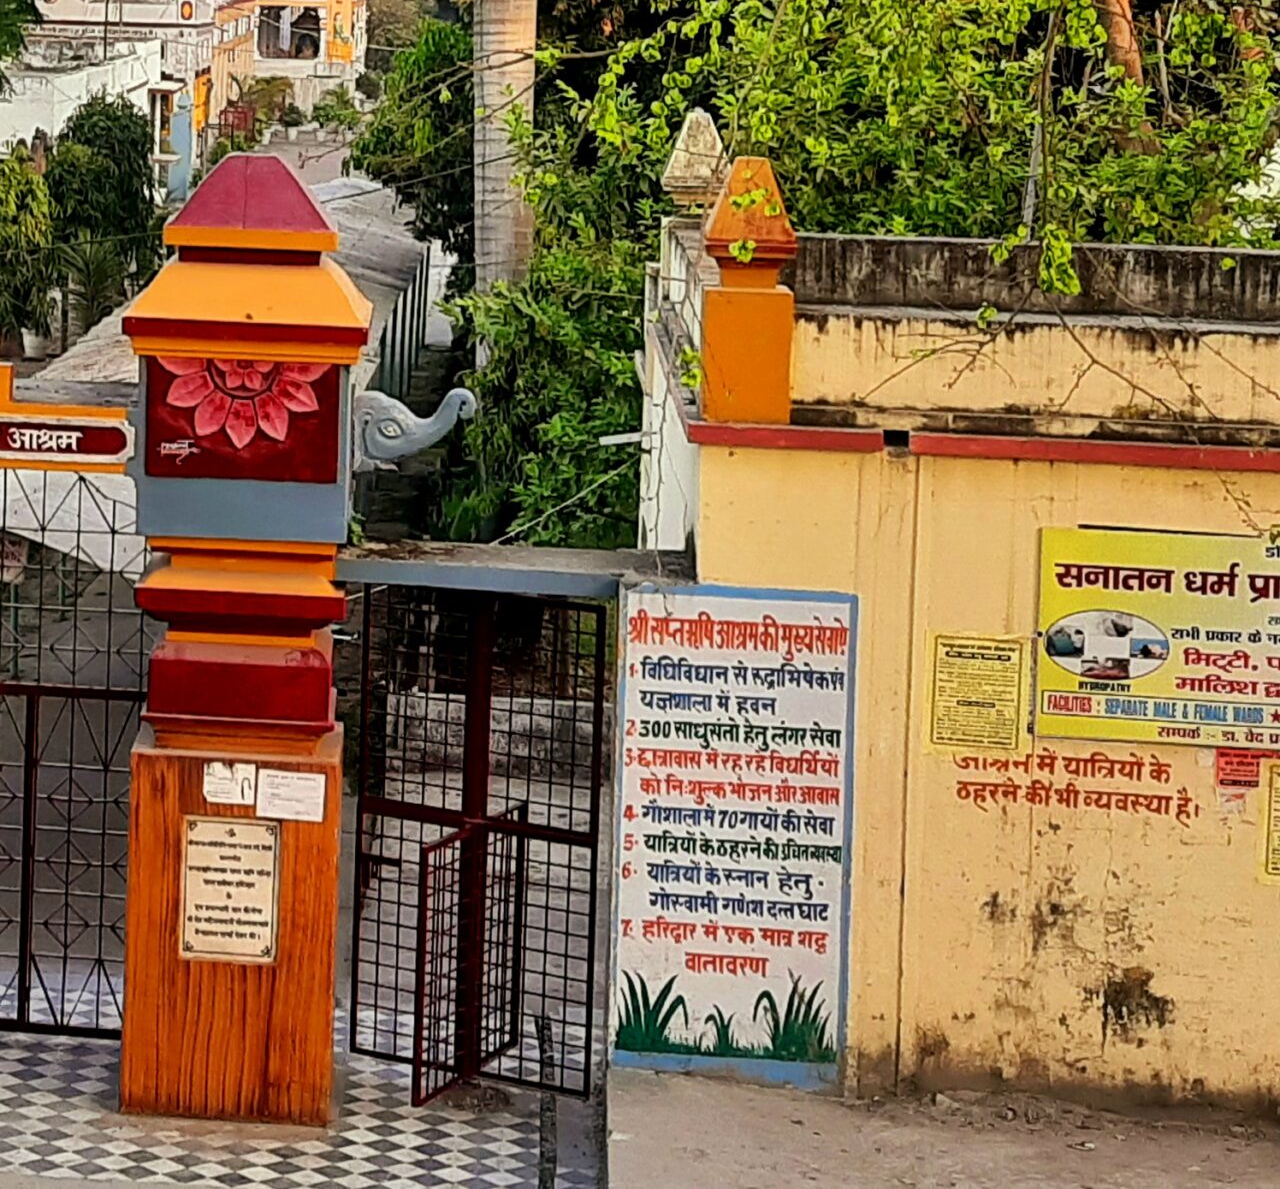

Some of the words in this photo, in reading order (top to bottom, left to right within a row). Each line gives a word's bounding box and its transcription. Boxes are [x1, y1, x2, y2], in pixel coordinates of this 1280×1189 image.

[7, 427, 83, 451] आश्रम
[1054, 562, 1175, 593] सनातन
[1184, 562, 1240, 597] धर्म
[1247, 574, 1280, 603] प्रा
[628, 608, 649, 645] श्री
[715, 620, 758, 650] आश्रम
[759, 614, 779, 652] की
[780, 624, 813, 662] मुख्य
[1171, 626, 1200, 640] सभी
[1205, 630, 1242, 643] प्रकार
[1248, 629, 1262, 643] के
[731, 660, 749, 685] से
[1175, 674, 1259, 695] मालिश
[639, 690, 712, 711] यज्ञशाला
[715, 689, 731, 713] में
[735, 695, 777, 716] हवन
[1048, 694, 1092, 713] FACILITIES
[1105, 698, 1148, 717] SEPARATE
[1153, 702, 1177, 719] MALE
[1182, 703, 1188, 719] &
[1193, 704, 1228, 722] FEMALE
[1233, 706, 1264, 724] WARDS
[639, 719, 671, 738] 500
[743, 716, 769, 751] हेतु
[771, 720, 807, 747] लंगर
[810, 721, 841, 748] सेवा
[1157, 725, 1202, 740] सम्पर्क
[1245, 727, 1264, 744] वेद
[637, 747, 702, 769] छात्रावास
[706, 747, 719, 770] में
[721, 753, 742, 776] रह
[745, 749, 768, 777] रहे
[1036, 747, 1057, 775] में
[1062, 751, 1145, 781] यात्रियों
[1149, 753, 1172, 784] के
[640, 771, 661, 796] को
[728, 775, 772, 802] भोजन
[775, 777, 797, 803] और
[798, 785, 840, 806] आवास
[956, 777, 1021, 812] ठहरने
[1024, 779, 1051, 807] की
[1054, 781, 1080, 809] भी
[1083, 790, 1173, 815] व्यवस्था
[641, 798, 701, 827] गौशाला
[702, 803, 716, 827] में
[718, 810, 738, 829] 70
[739, 806, 780, 832] गायों
[781, 809, 801, 833] की
[801, 809, 835, 837] सेवा
[642, 829, 697, 855] यात्रियों
[699, 831, 715, 856] के
[715, 835, 761, 865] ठहरने
[762, 837, 780, 860] की
[780, 838, 810, 862] उचित
[646, 859, 702, 884] यात्रियों
[704, 861, 721, 885] के
[721, 868, 769, 889] स्नान
[776, 865, 813, 901] हेतु
[649, 886, 719, 914] गोस्वामी
[721, 892, 764, 917] गणेश
[766, 900, 795, 921] दत्त
[795, 902, 829, 922] घाट
[641, 915, 697, 944] हरिद्वार
[701, 919, 719, 942] में
[721, 925, 755, 945] एक
[758, 927, 794, 948] मात्र
[685, 951, 769, 978] वातावरण
